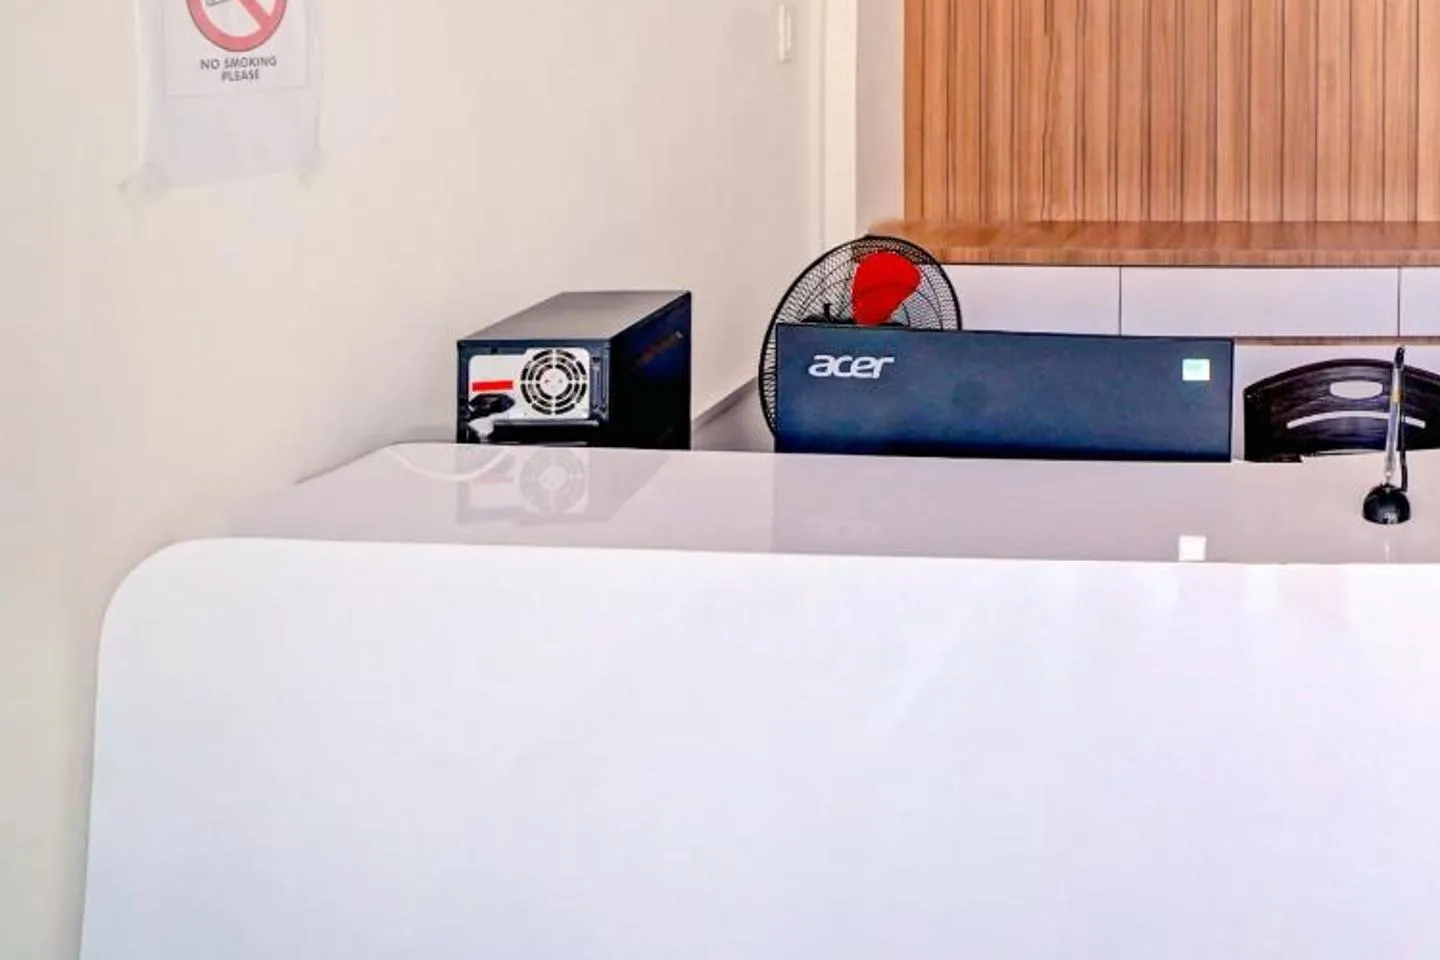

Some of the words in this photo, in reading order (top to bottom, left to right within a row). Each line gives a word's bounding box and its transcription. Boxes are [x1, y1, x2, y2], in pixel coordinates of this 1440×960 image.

[200, 58, 220, 70] NO
[224, 56, 277, 69] SMOKING
[222, 69, 260, 82] PLEASE
[808, 354, 895, 379] acer
